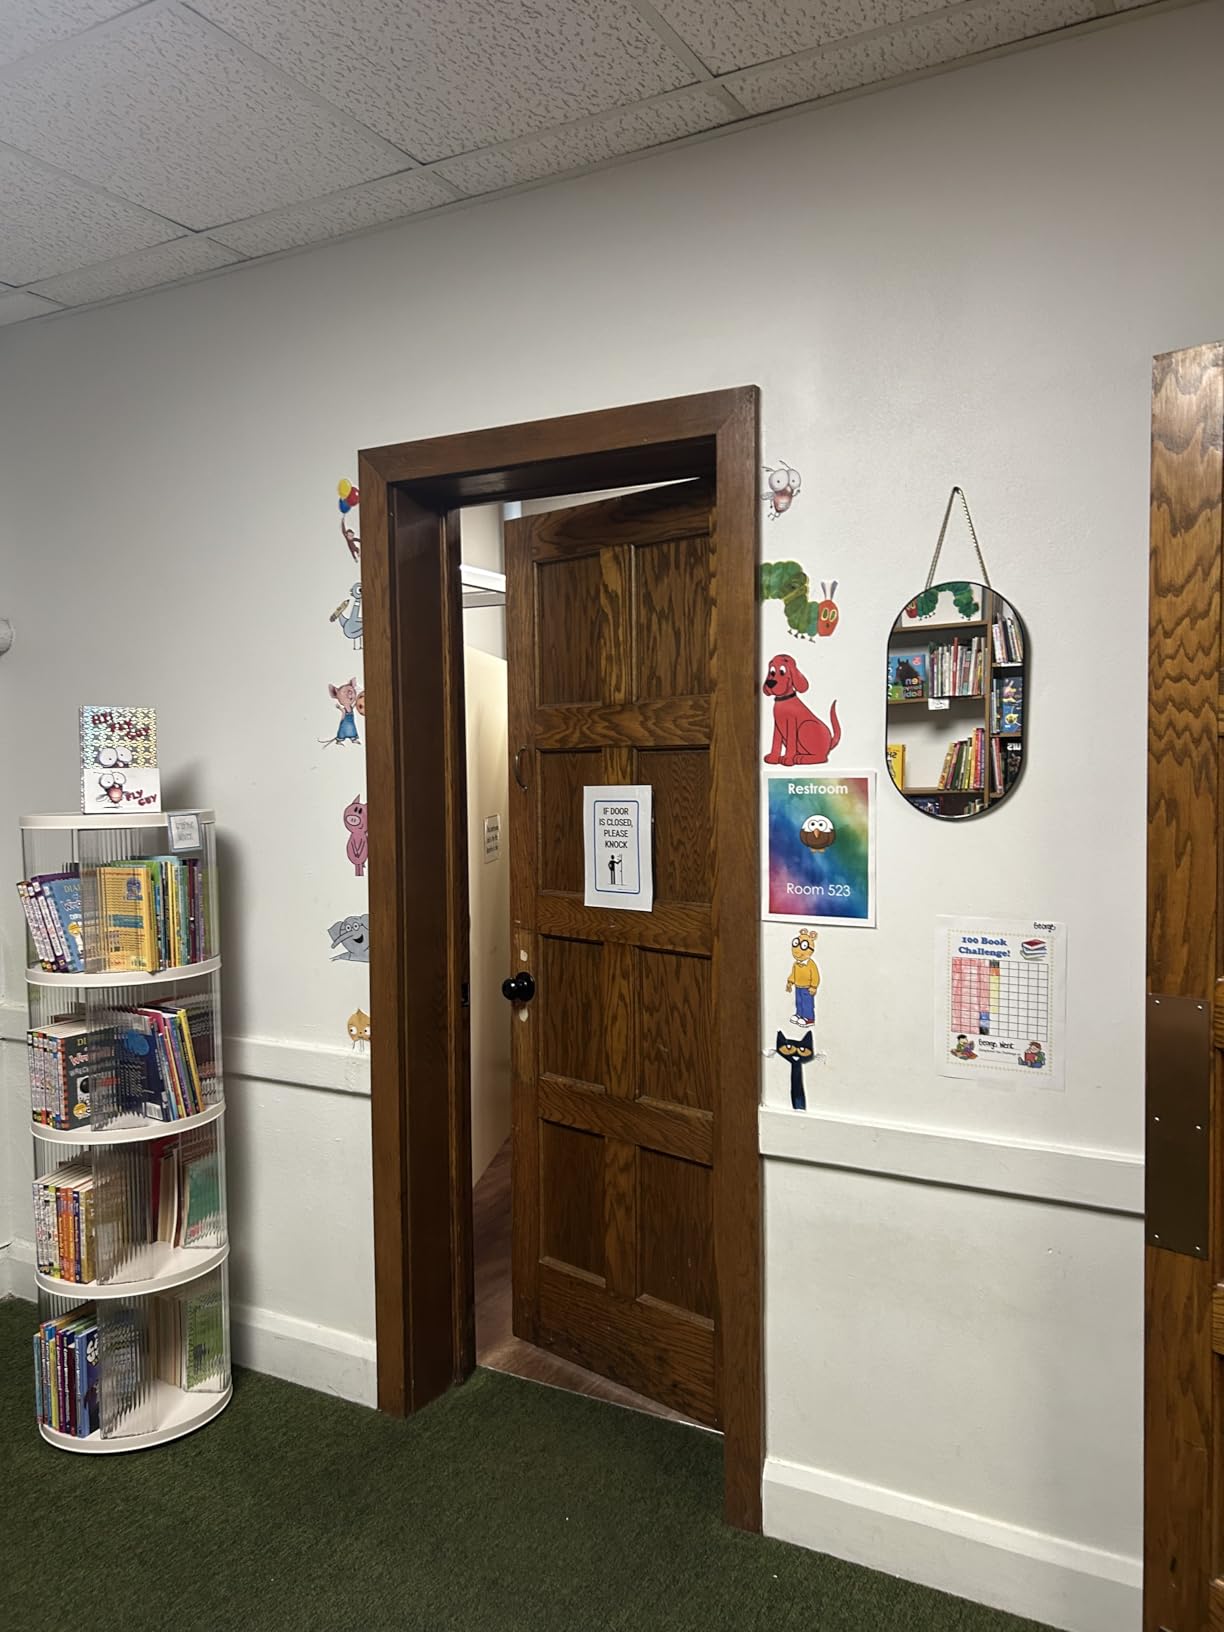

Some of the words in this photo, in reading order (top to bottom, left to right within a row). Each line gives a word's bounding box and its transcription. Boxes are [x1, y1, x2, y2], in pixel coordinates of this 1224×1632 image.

[788, 783, 849, 795] Restroom
[124, 789, 143, 802] FLY
[137, 794, 157, 806] GUY
[602, 807, 610, 815] IF
[610, 807, 629, 816] DOOR
[599, 818, 606, 826] IS
[606, 818, 633, 828] CLOSED,
[603, 829, 629, 838] PLEASE
[604, 840, 628, 849] KNOCK
[786, 882, 825, 896] Room
[827, 884, 851, 897] 523
[961, 936, 979, 945] 100
[980, 937, 1008, 947] Book
[958, 946, 1011, 958] Challenge!
